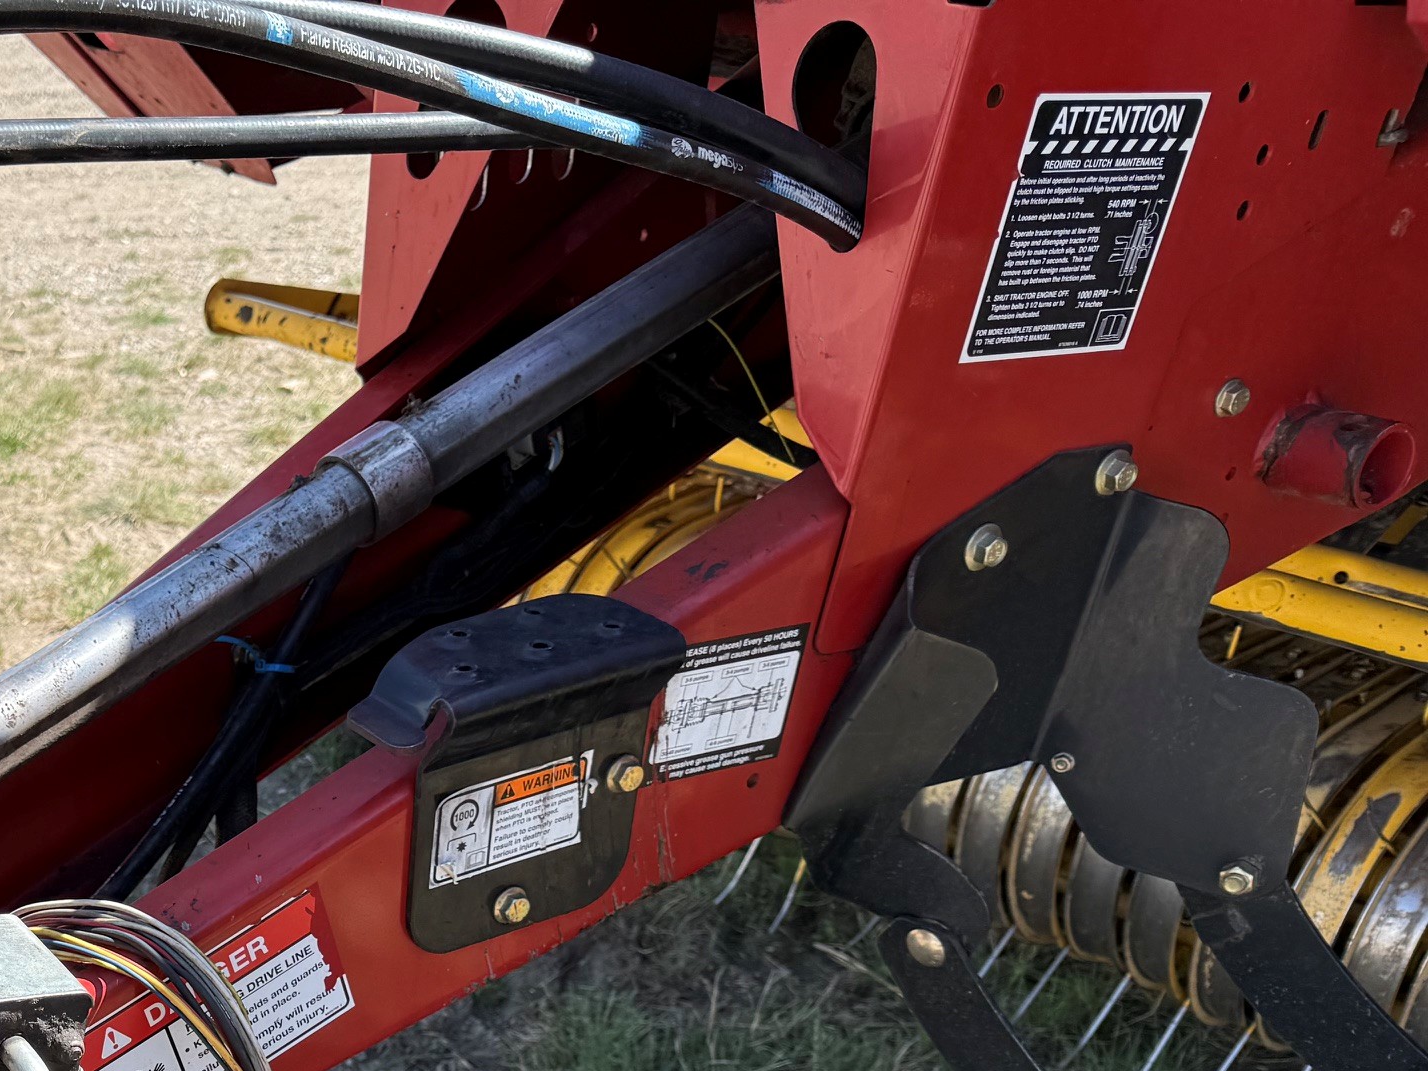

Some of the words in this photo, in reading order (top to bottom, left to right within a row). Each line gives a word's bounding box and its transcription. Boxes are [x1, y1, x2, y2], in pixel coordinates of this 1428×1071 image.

[1049, 104, 1186, 135] ATTENTION
[1043, 159, 1081, 169] REQUIRED
[1083, 158, 1113, 168] CLUTCH
[1115, 157, 1165, 167] MAINTENANCE
[1108, 199, 1121, 208] 540
[1120, 198, 1137, 207] RPM
[1076, 290, 1093, 299] 1000
[1092, 288, 1109, 298] RPM
[988, 327, 1004, 335] MORE
[1004, 325, 1033, 334] COMPLETE
[1033, 322, 1068, 332] INFORMATION
[1068, 321, 1086, 329] REFER
[658, 757, 695, 773] Ecessive
[454, 808, 475, 823] 1000
[246, 962, 283, 992] DRIVE
[284, 944, 312, 968] LINE
[269, 982, 289, 999] and
[289, 959, 324, 988] guards
[259, 1007, 269, 1018] in
[270, 987, 301, 1012] place.
[284, 1003, 303, 1021] will
[260, 1023, 294, 1051] erious
[295, 1001, 329, 1029] injury.
